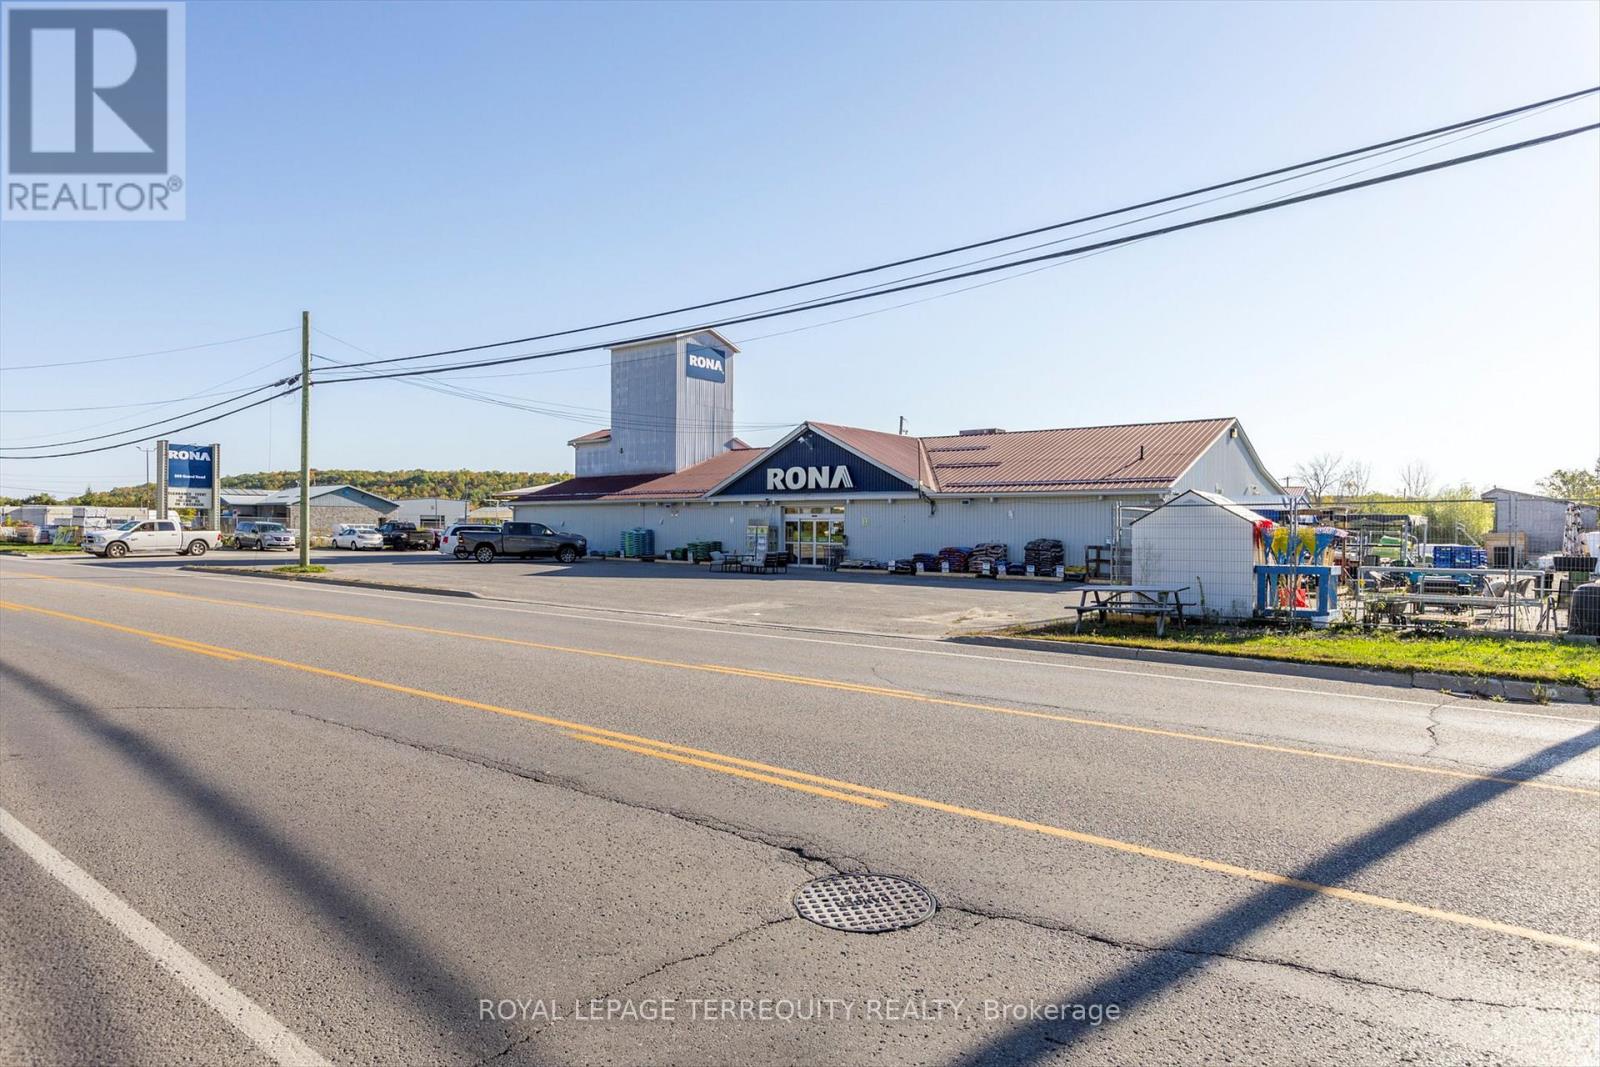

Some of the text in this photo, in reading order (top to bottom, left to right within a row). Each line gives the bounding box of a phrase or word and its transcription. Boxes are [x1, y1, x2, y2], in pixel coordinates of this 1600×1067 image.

[689, 354, 725, 374] RONA
[168, 450, 211, 461] RONA
[766, 465, 854, 490] RONA
